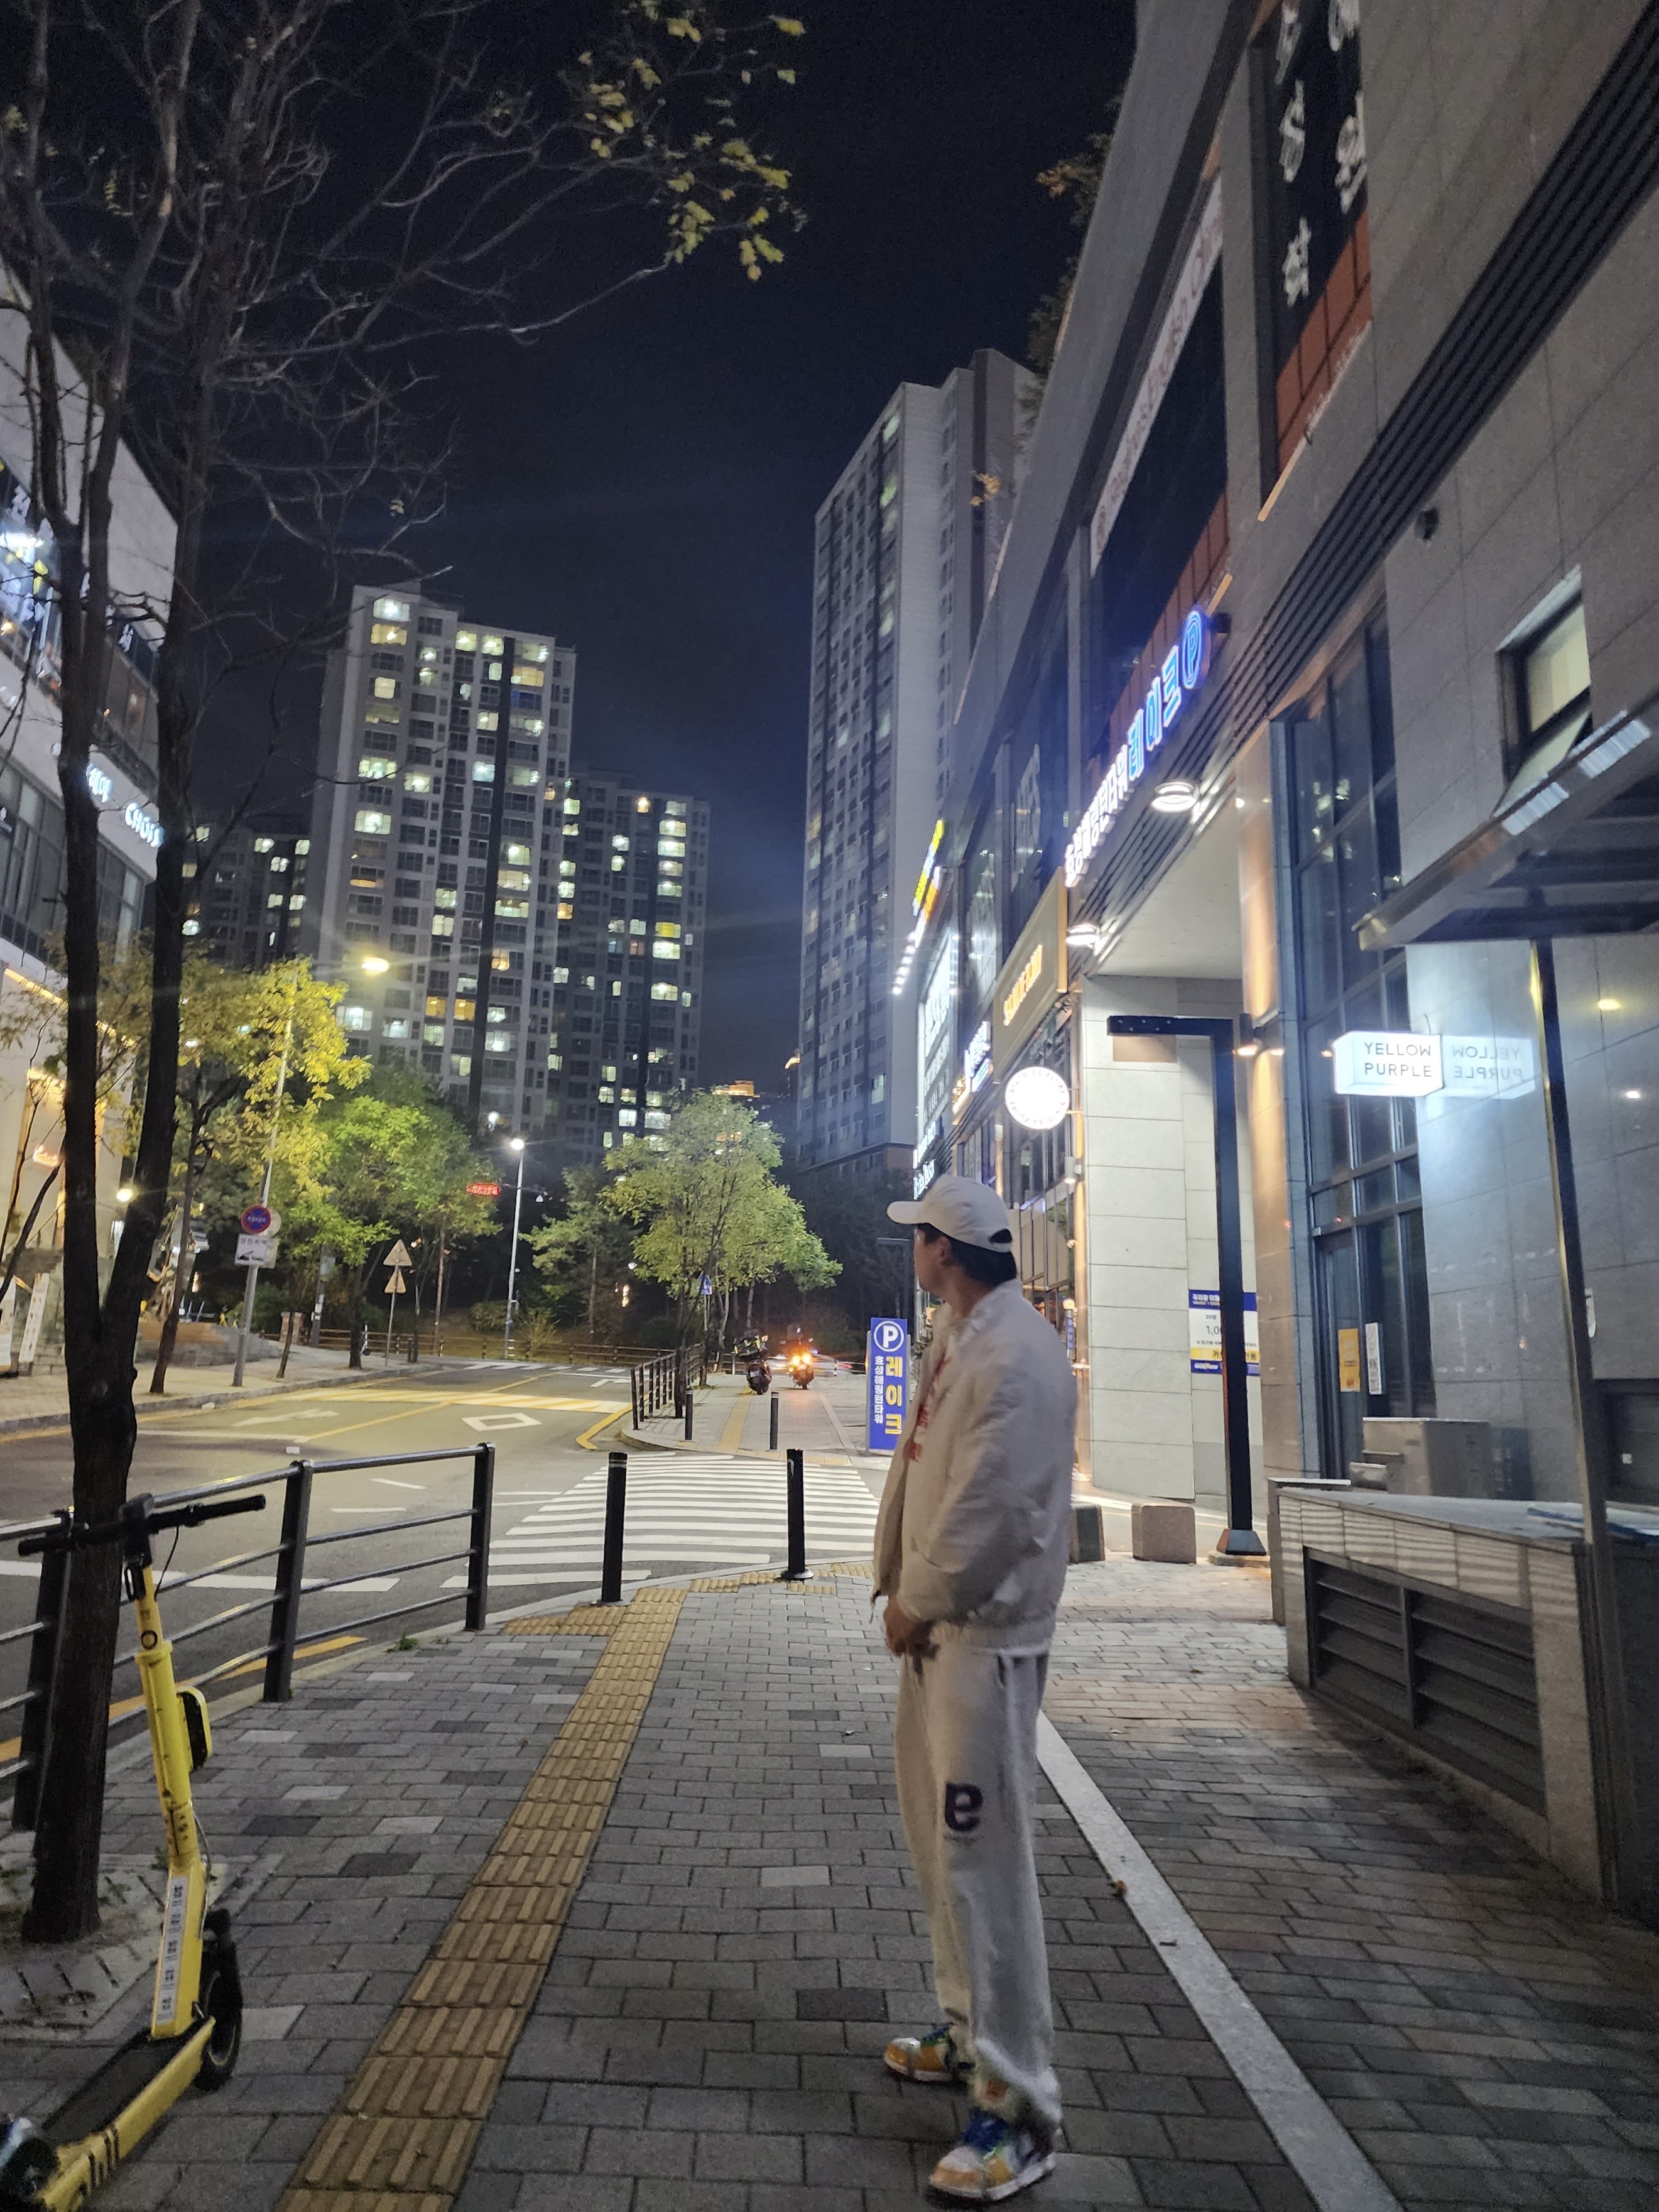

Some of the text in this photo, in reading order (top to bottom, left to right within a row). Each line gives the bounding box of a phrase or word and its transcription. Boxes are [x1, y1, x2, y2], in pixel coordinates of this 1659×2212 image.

[1128, 645, 1182, 782] 레이크
[1364, 1042, 1431, 1057] YELLOW
[1364, 1062, 1432, 1077] PURPLE
[885, 1355, 903, 1435] 레이크
